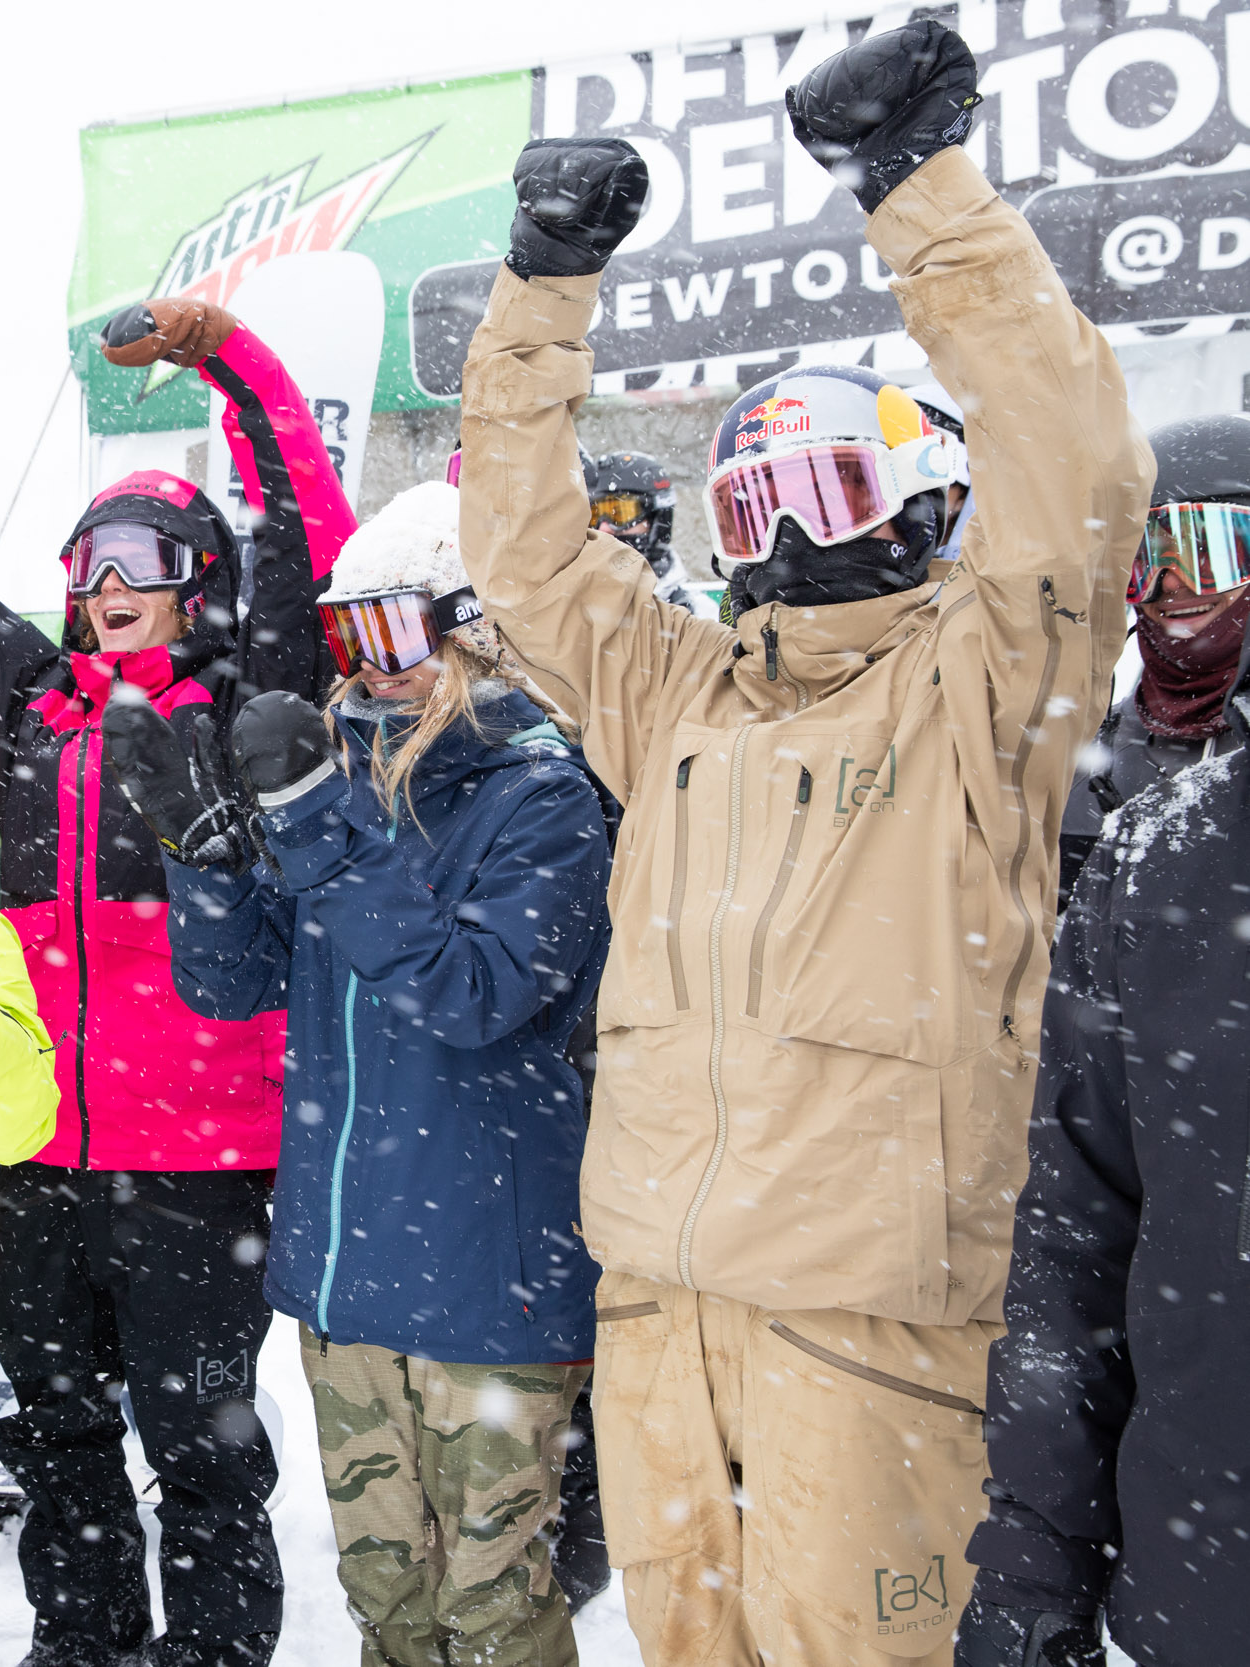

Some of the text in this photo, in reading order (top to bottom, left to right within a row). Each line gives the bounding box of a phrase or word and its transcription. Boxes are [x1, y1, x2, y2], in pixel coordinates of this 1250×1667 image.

[735, 415, 810, 451] Red Bull
[877, 1609, 954, 1636] BURTON
